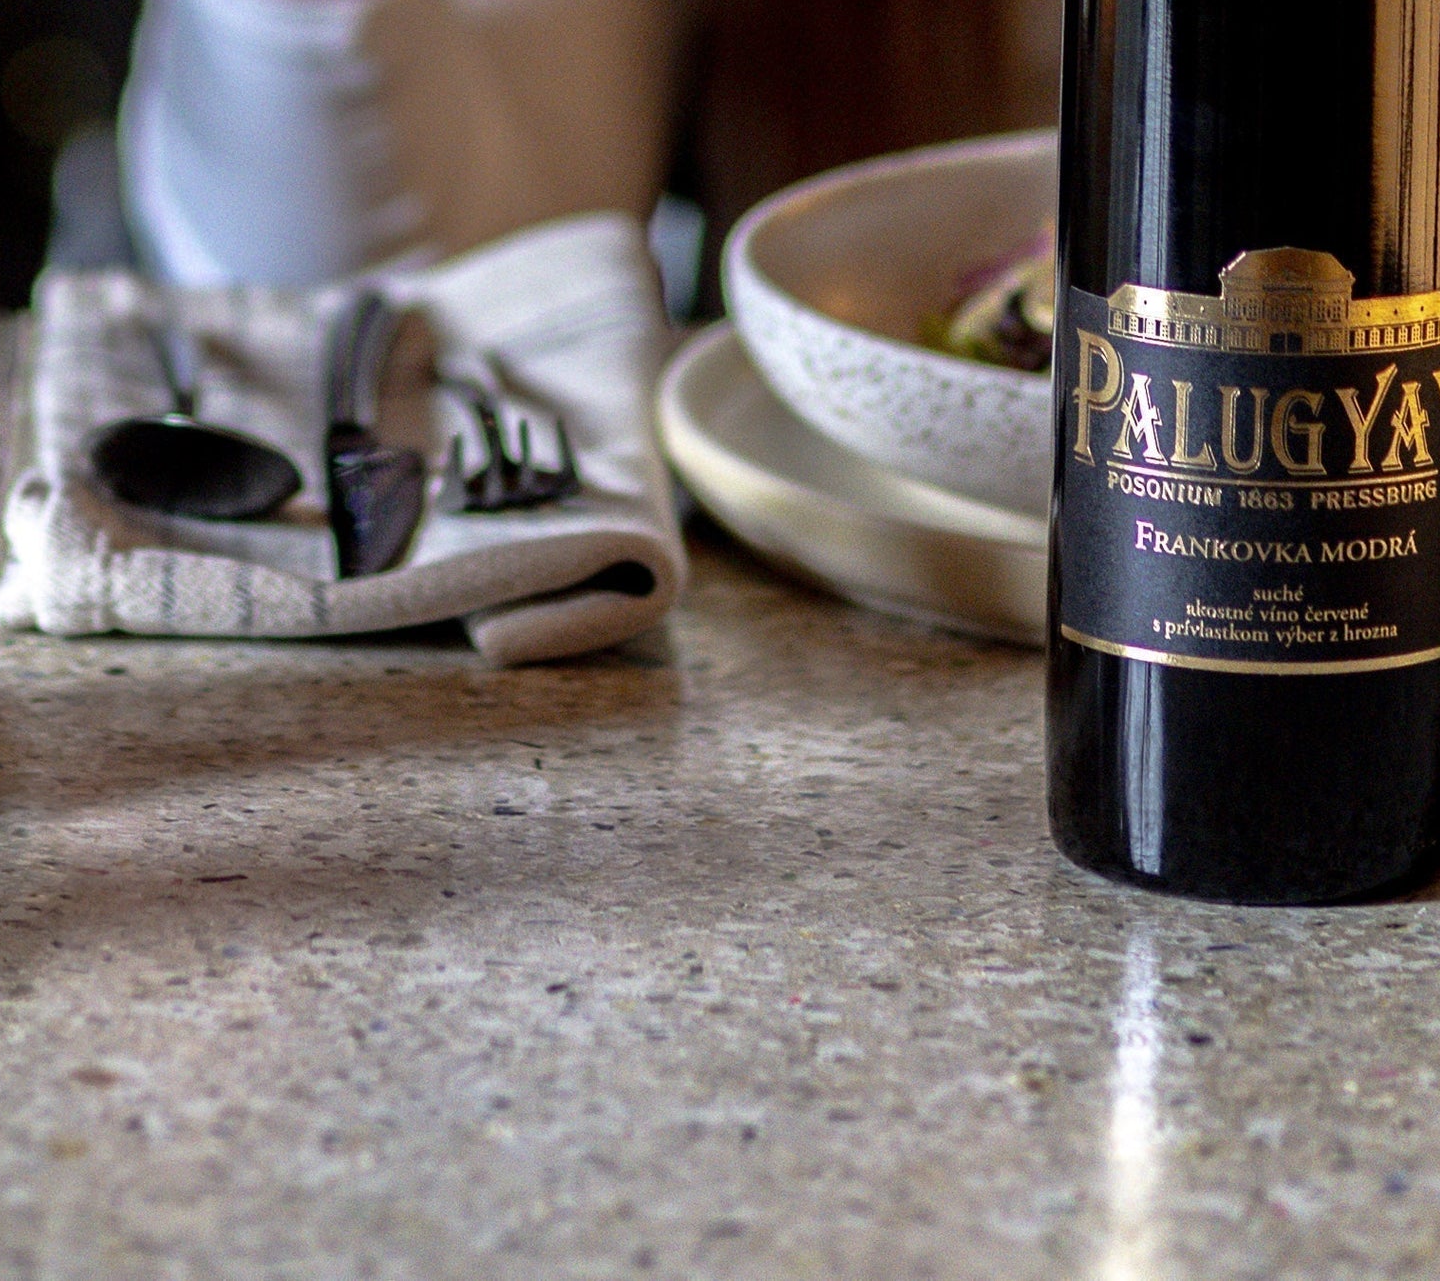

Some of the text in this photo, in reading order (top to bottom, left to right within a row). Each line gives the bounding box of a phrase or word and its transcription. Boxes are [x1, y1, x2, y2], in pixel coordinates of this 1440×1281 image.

[1107, 470, 1437, 510] POSONIUM 1863 PRESSBURG
[1135, 520, 1418, 563] FRANKOVKA MODRÁ
[1253, 584, 1304, 601] suché
[1186, 598, 1369, 622] akostné víno červené
[1152, 618, 1398, 648] s prívlastkom výber z hrozna
